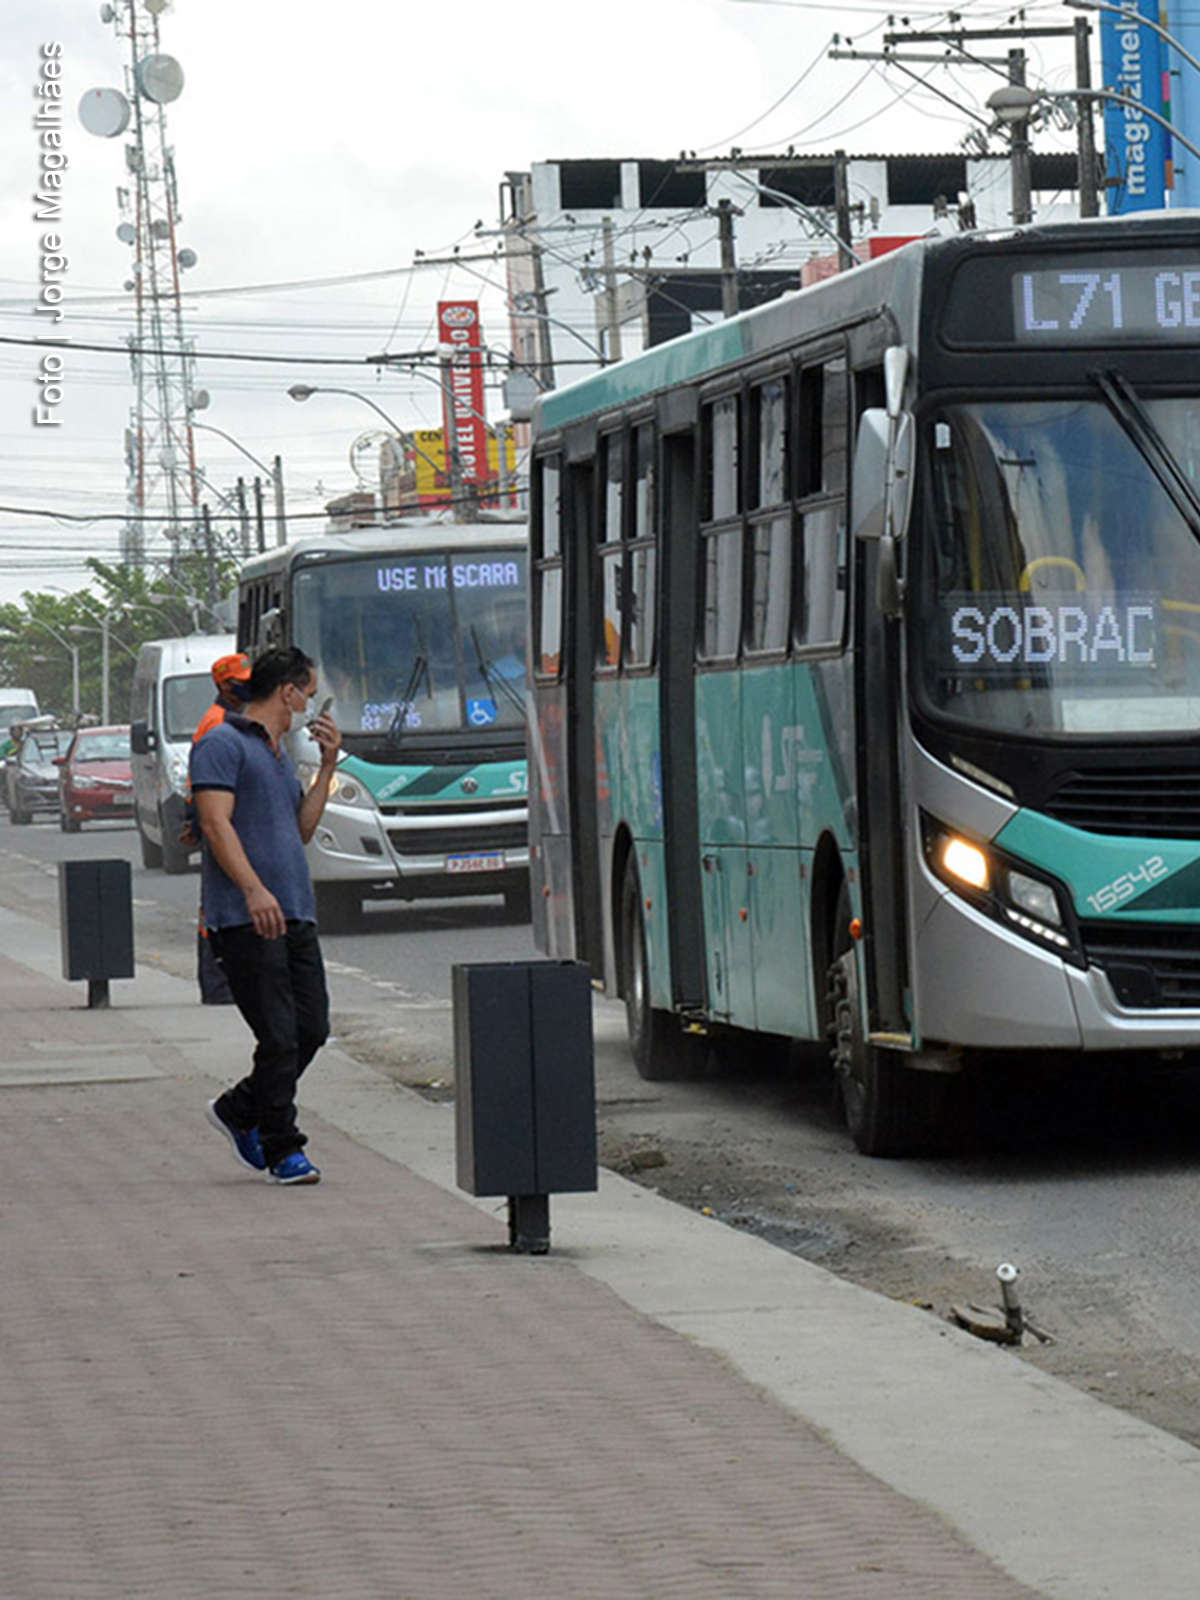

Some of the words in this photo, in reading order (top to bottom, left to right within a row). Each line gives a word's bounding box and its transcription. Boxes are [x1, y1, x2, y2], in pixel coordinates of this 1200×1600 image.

[1022, 273, 1122, 330] L71
[377, 567, 418, 592] USE
[1086, 855, 1169, 913] 15542
